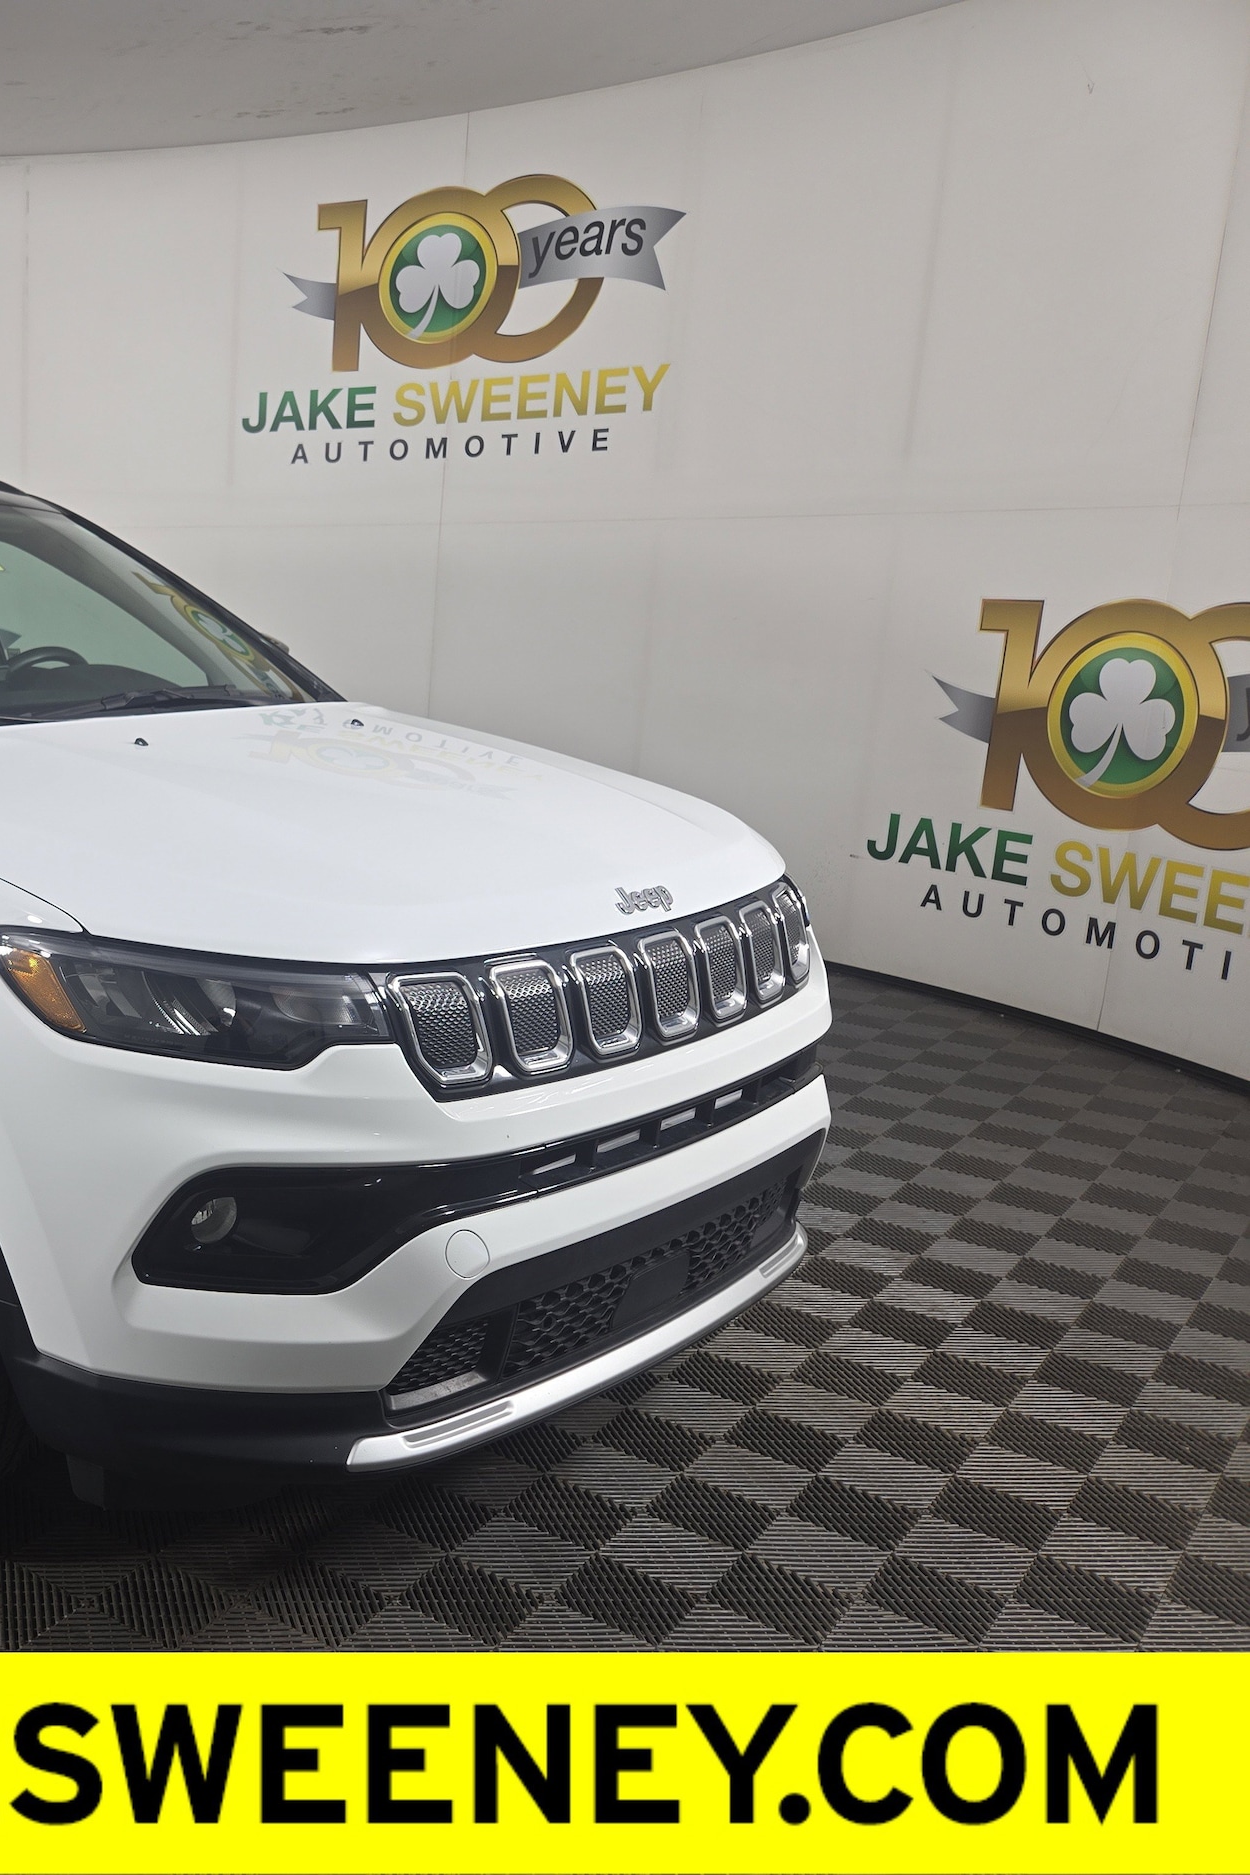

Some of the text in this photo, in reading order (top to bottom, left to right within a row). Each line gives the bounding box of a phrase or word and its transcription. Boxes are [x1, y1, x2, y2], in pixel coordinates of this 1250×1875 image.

[528, 216, 645, 278] years
[241, 364, 671, 434] JAKE SWEENEY
[290, 428, 610, 465] AUTOMOTIVE
[614, 885, 674, 914] Jeep
[866, 813, 1250, 938] JAKE SWEE
[920, 884, 1232, 980] AUTOMOTI
